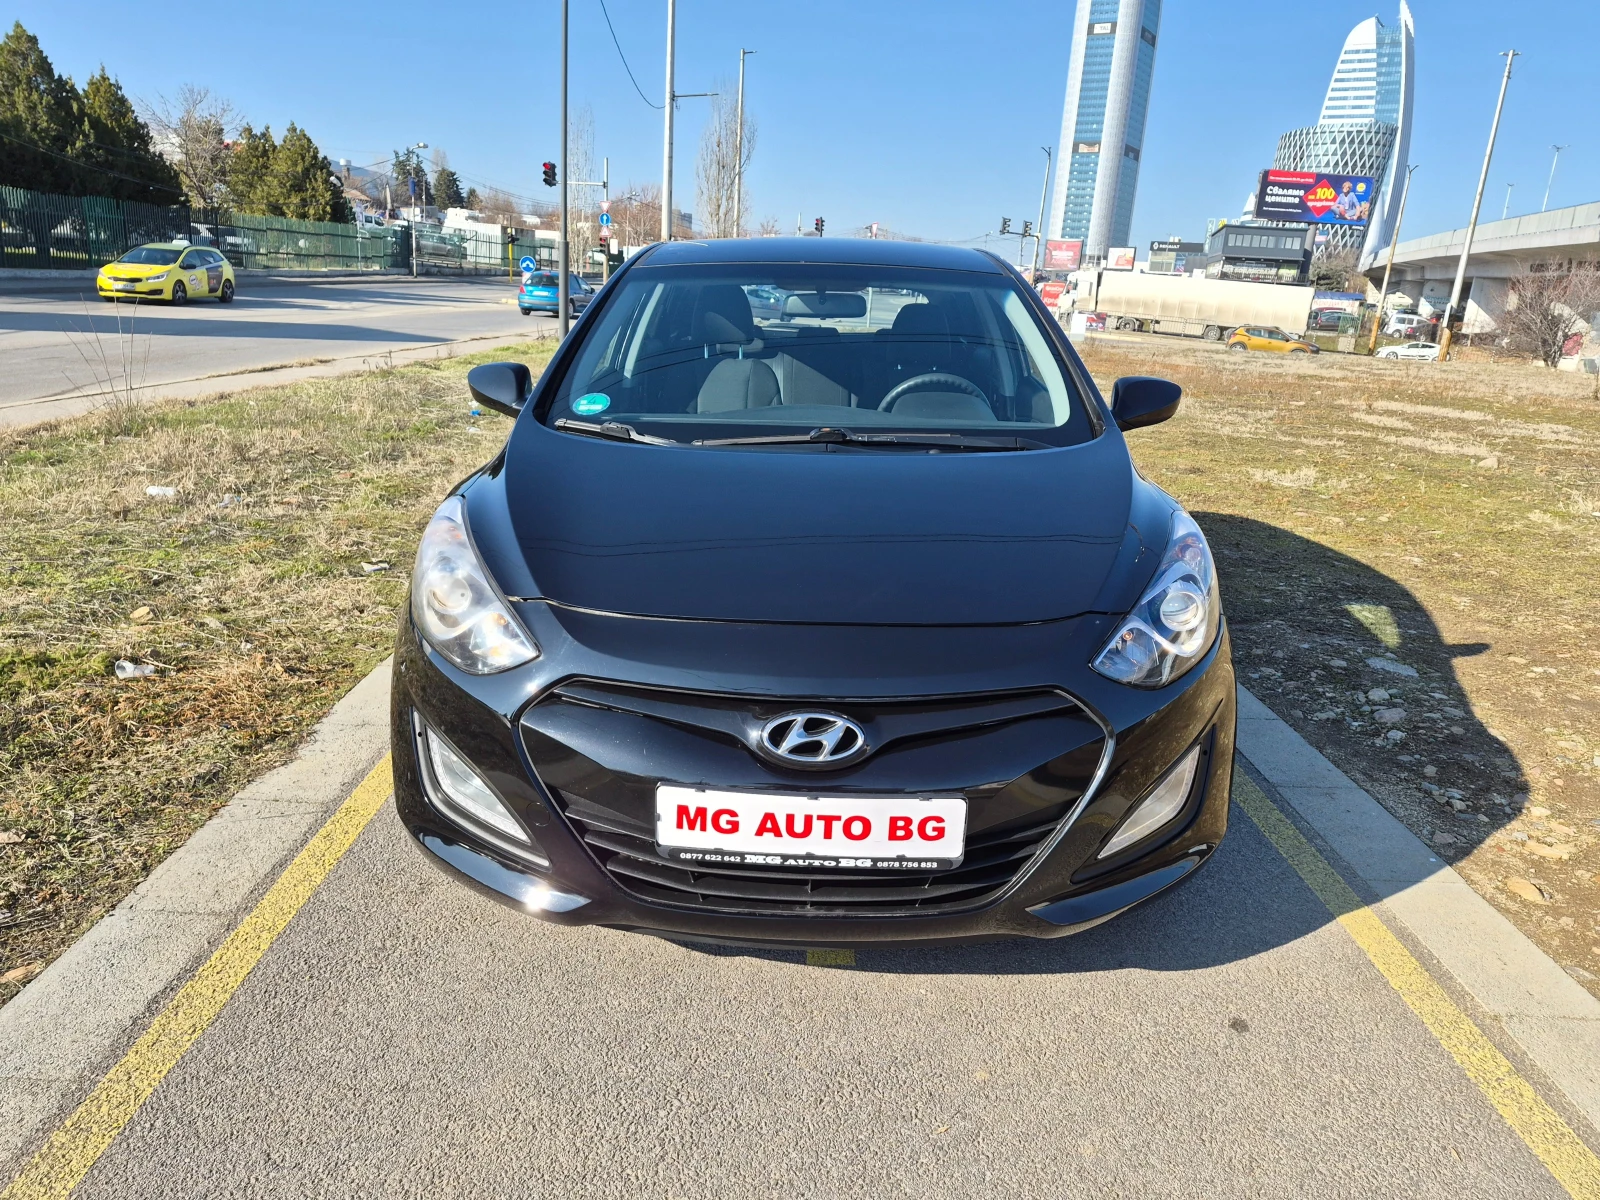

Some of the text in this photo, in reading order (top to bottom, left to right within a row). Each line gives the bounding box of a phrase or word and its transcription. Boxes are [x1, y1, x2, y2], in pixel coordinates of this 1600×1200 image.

[1267, 186, 1304, 196] Сваляме
[1316, 188, 1335, 200] 100
[1265, 195, 1300, 203] цените
[676, 804, 946, 842] MG AUTO BG
[680, 852, 703, 860] 0877
[744, 854, 783, 864] MG
[784, 858, 837, 867] AUTO
[838, 858, 873, 868] BG
